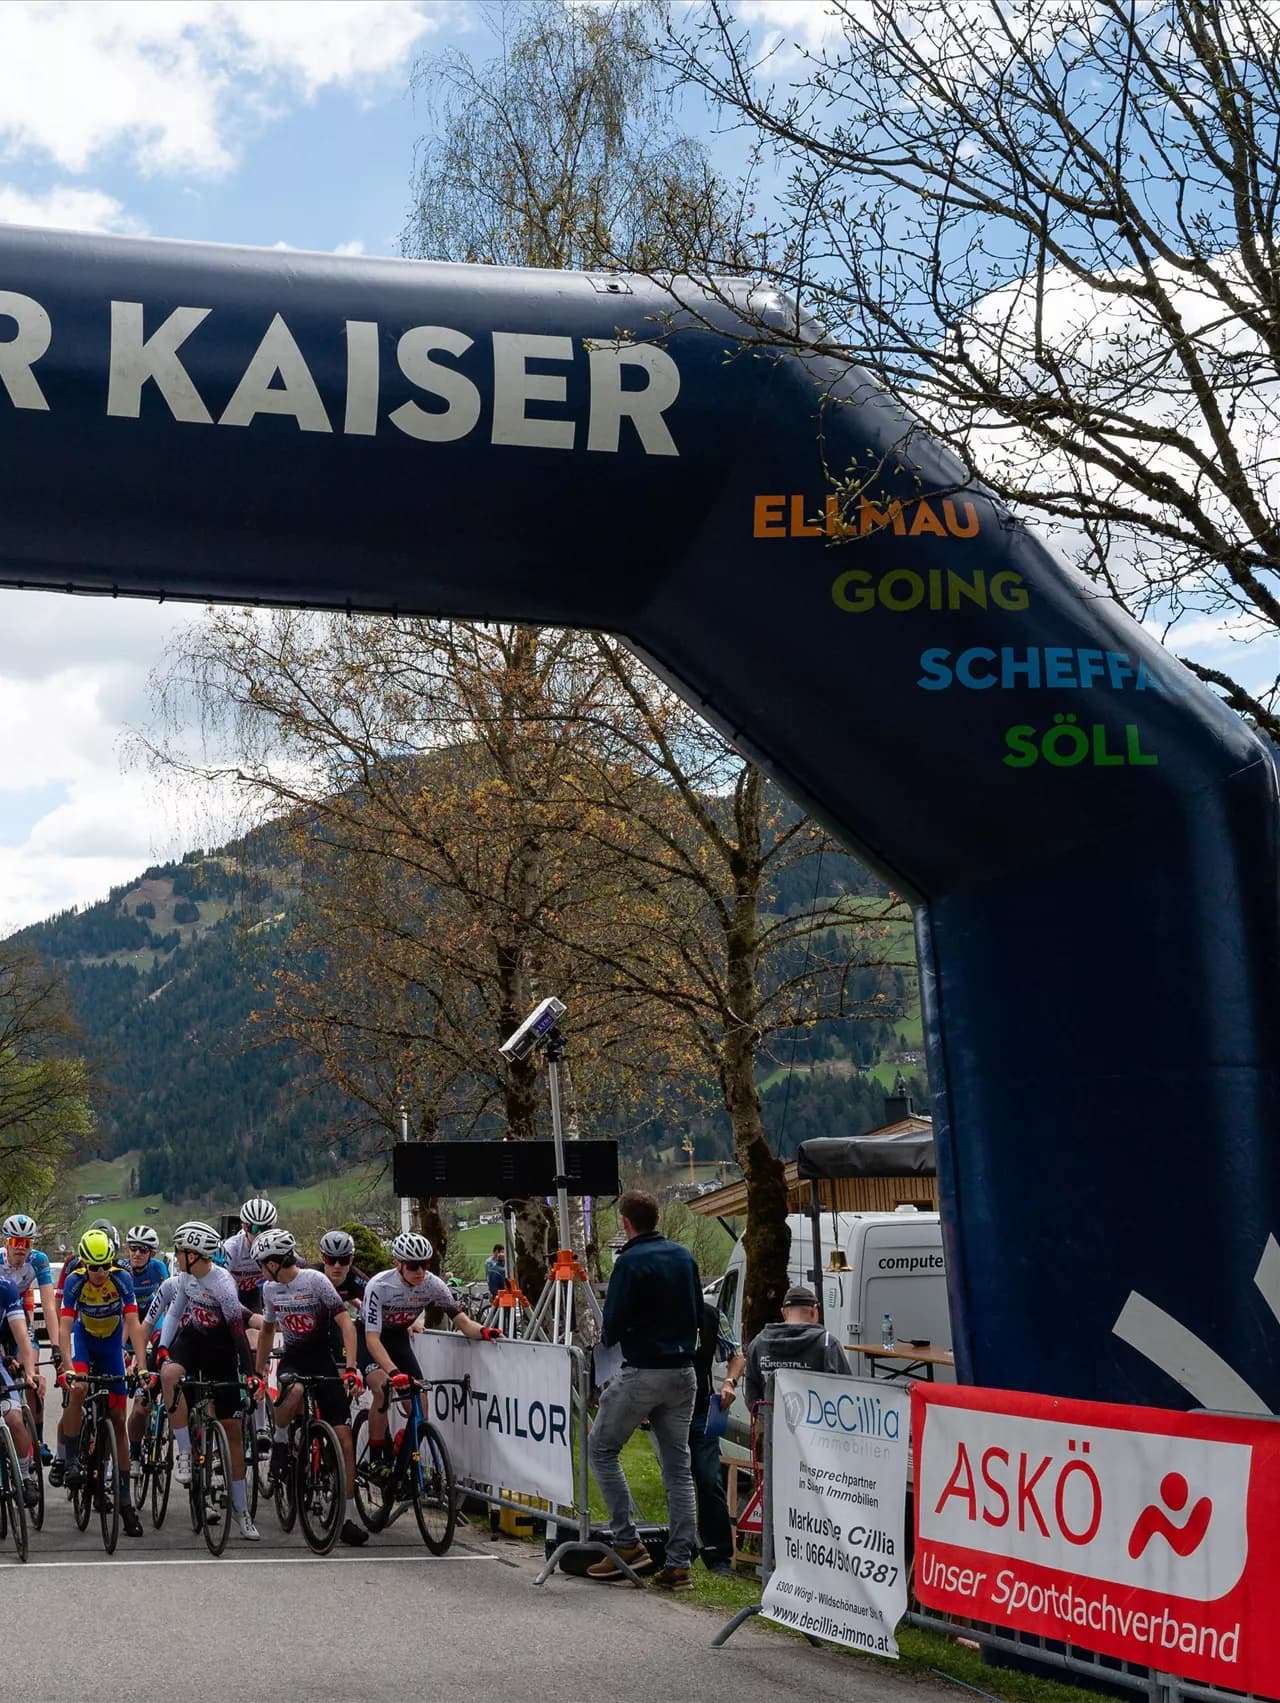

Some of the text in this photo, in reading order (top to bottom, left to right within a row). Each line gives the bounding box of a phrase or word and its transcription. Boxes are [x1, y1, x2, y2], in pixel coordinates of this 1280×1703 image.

[107, 300, 681, 457] KAISER
[753, 495, 980, 539] ELLMAU
[831, 568, 1030, 613] GOING
[1002, 713, 1158, 766] SÖLL
[187, 1232, 202, 1247] 65
[878, 1254, 945, 1272] compute
[367, 1290, 380, 1326] RH77
[470, 1390, 568, 1447] TAILOR
[806, 1389, 899, 1439] DeCillia
[826, 1485, 879, 1508] Immobilien
[934, 1438, 1103, 1546] ASKÖ
[785, 1536, 803, 1561] Tel:
[788, 1507, 828, 1537] Markus
[848, 1526, 895, 1556] Cillia
[794, 1585, 814, 1603] Wörgl
[818, 1591, 869, 1617] Wildschönauer
[922, 1551, 1241, 1663] Unser Sportdachverband
[772, 1604, 889, 1653] www.decillia-immo.at
